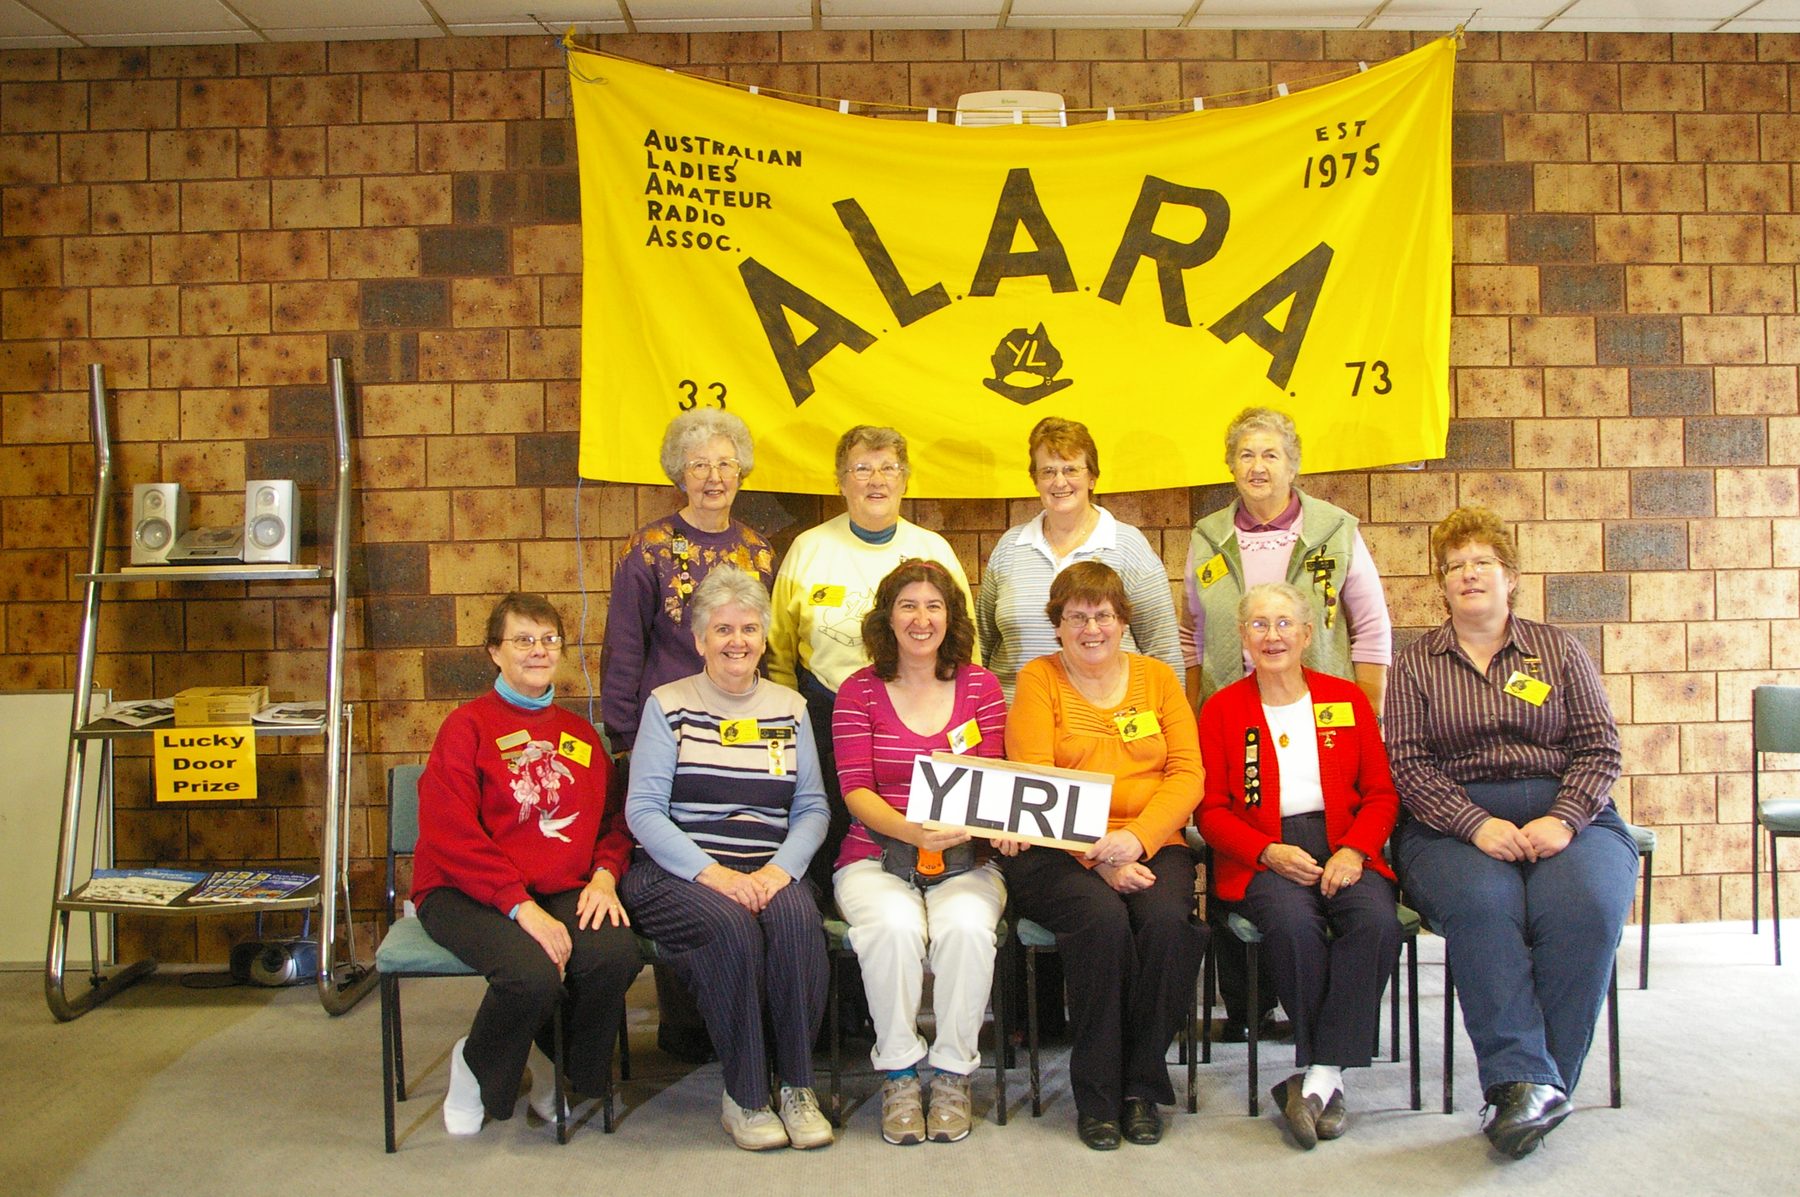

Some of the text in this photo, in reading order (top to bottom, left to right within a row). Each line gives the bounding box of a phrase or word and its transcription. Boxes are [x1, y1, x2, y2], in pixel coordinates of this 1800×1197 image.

[1315, 120, 1367, 142] EST
[644, 129, 802, 167] AUSTRALIAN
[1304, 143, 1381, 189] 1975
[645, 172, 773, 209] AMATEUR
[647, 200, 726, 227] RADIO
[646, 225, 741, 252] ASSOC.
[1006, 340, 1047, 367] YL
[1345, 360, 1393, 397] 73
[163, 734, 245, 749] Lucky
[173, 757, 237, 771] Door
[173, 780, 240, 793] Prize
[918, 760, 1102, 844] YLRL
